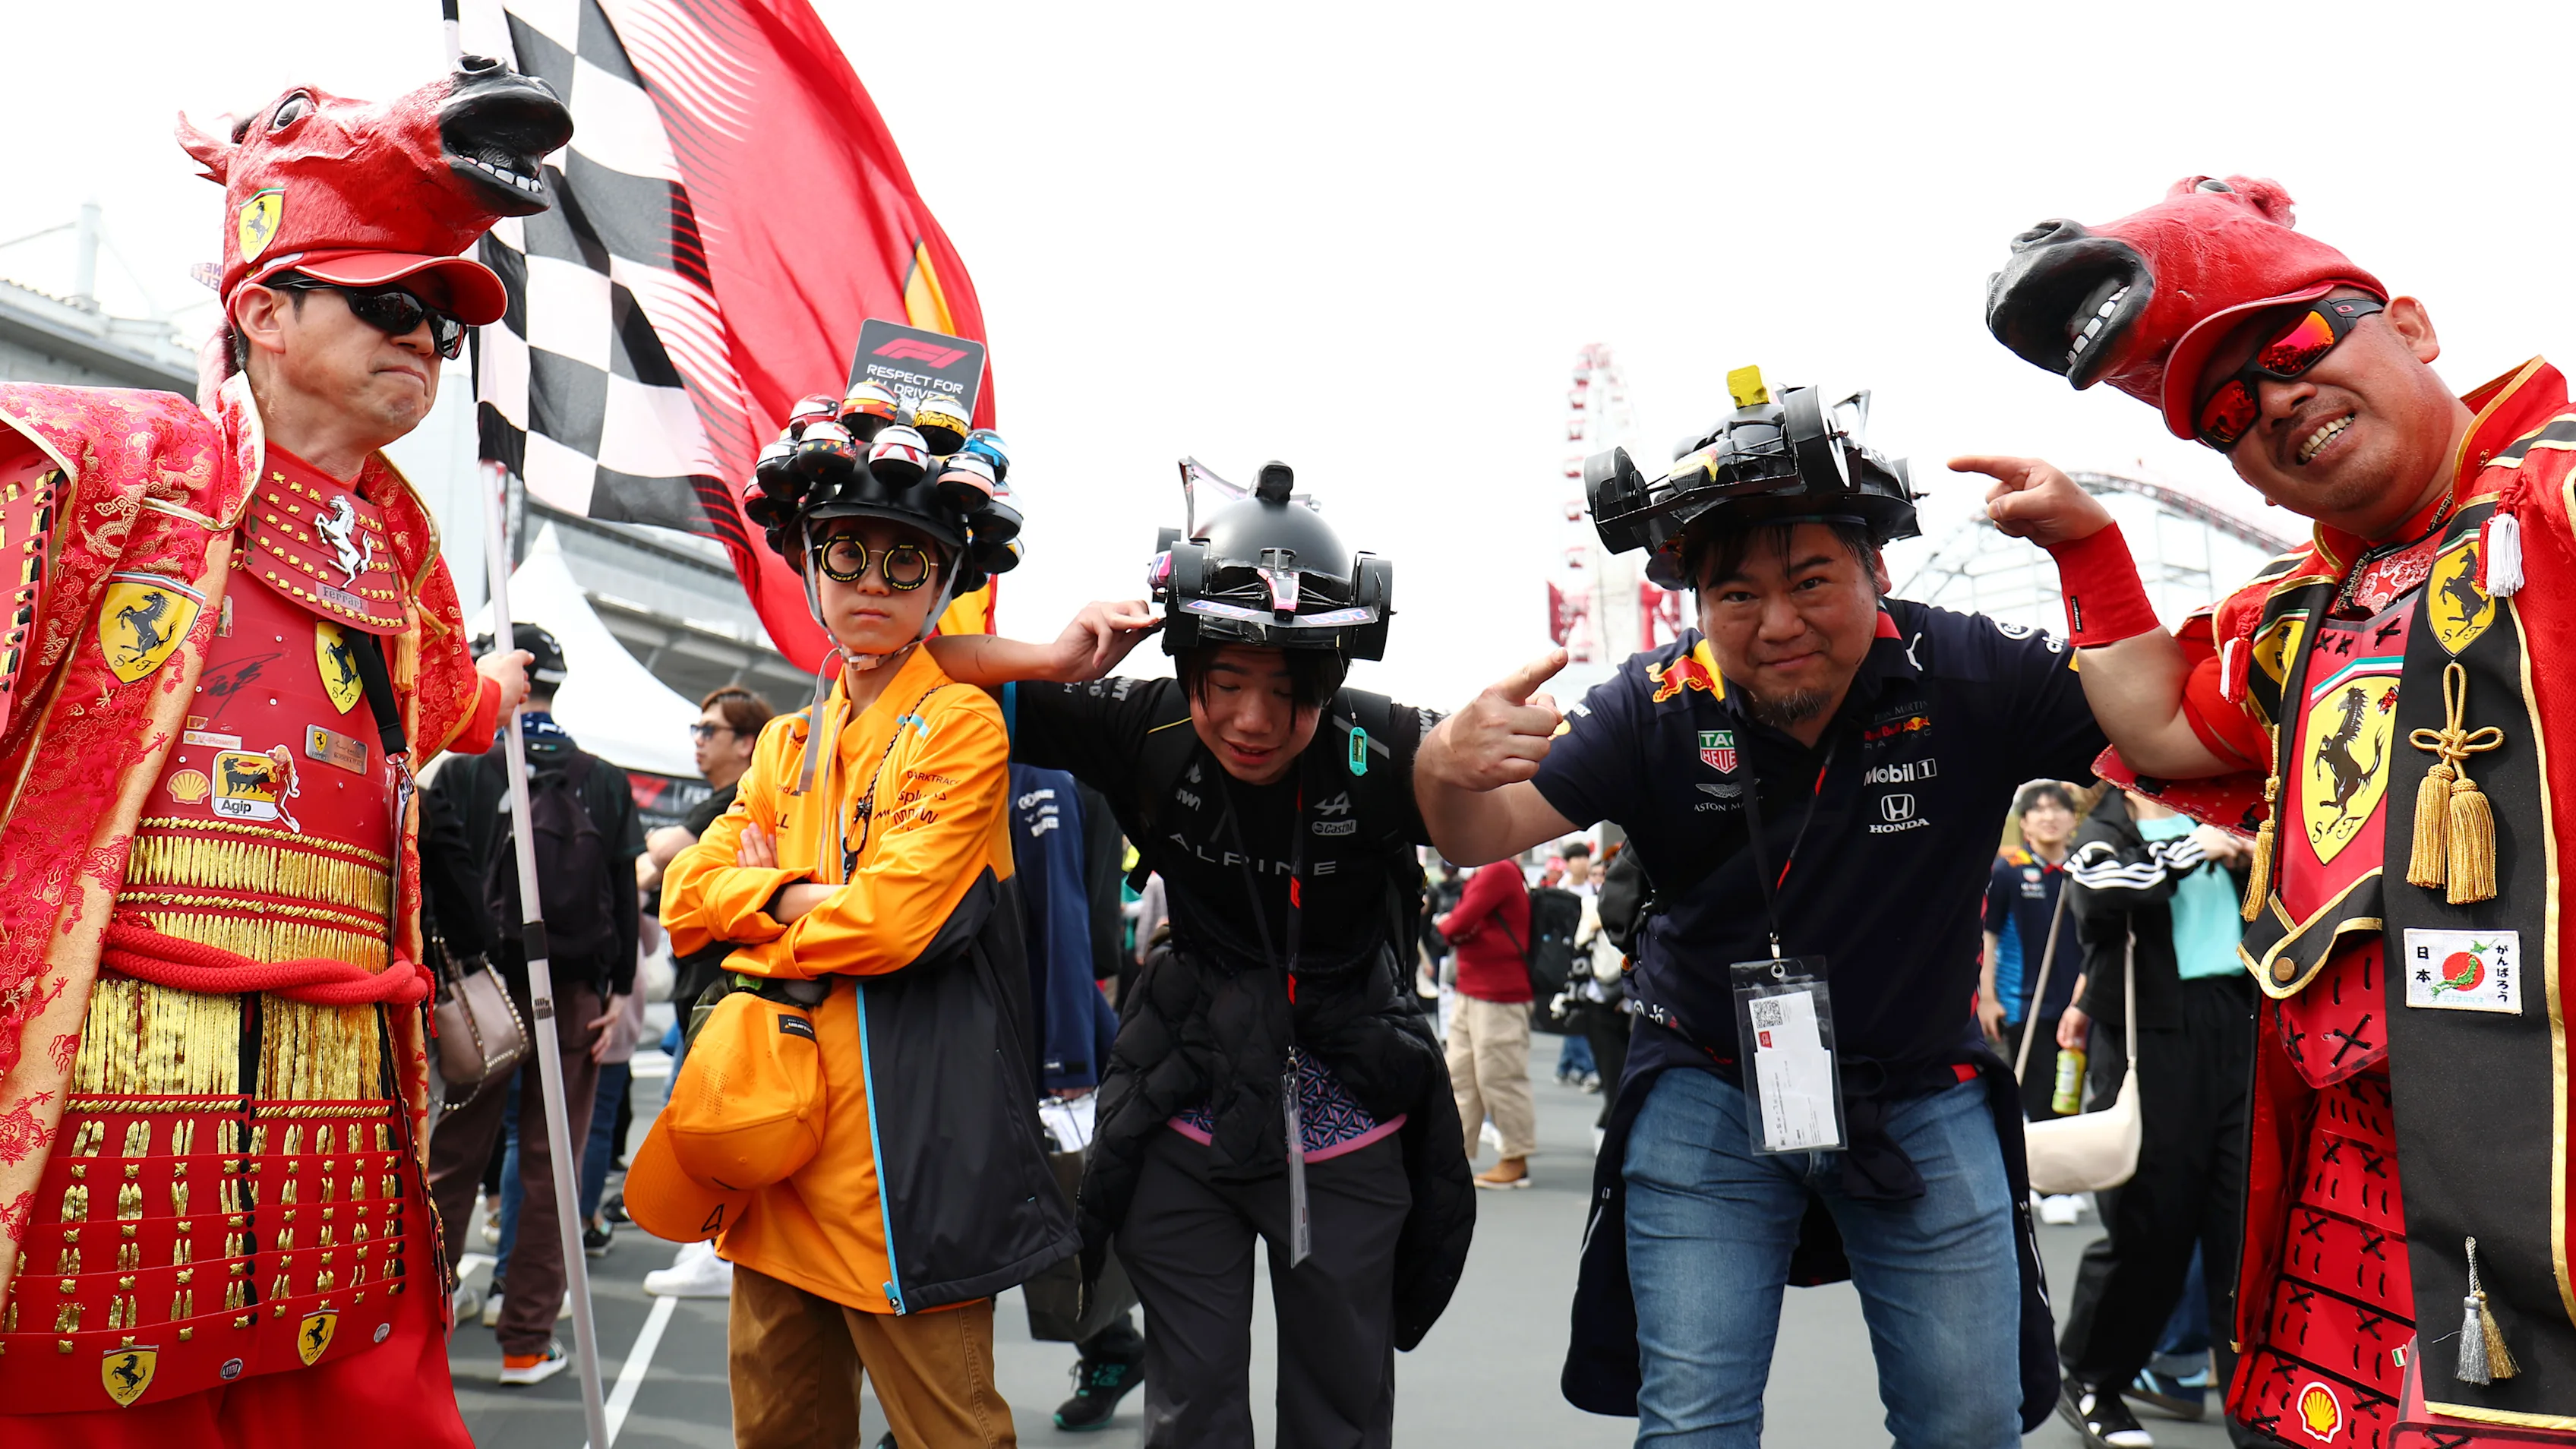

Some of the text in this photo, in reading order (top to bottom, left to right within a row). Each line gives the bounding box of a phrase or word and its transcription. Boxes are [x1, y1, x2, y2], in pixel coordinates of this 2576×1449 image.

[872, 338, 968, 369] F1
[867, 364, 933, 387] RESPECT
[933, 379, 964, 394] FOR
[894, 383, 955, 400] DRIVE
[323, 586, 364, 609] Ferrari
[1192, 601, 1255, 617] BWT
[1309, 609, 1368, 624] BWT
[1864, 729, 1932, 750] RAING
[1702, 750, 1736, 770] HEUE
[907, 771, 961, 786] DARKTRAC
[1864, 763, 1915, 787] Mobil
[221, 799, 251, 814] Agip
[1694, 802, 1727, 813] ASTON
[1869, 818, 1930, 833] HONDA
[2312, 821, 2322, 844] S
[1169, 832, 1337, 876] ALPINE
[2416, 946, 2432, 983] 日本
[2496, 945, 2510, 1002] がんばろう
